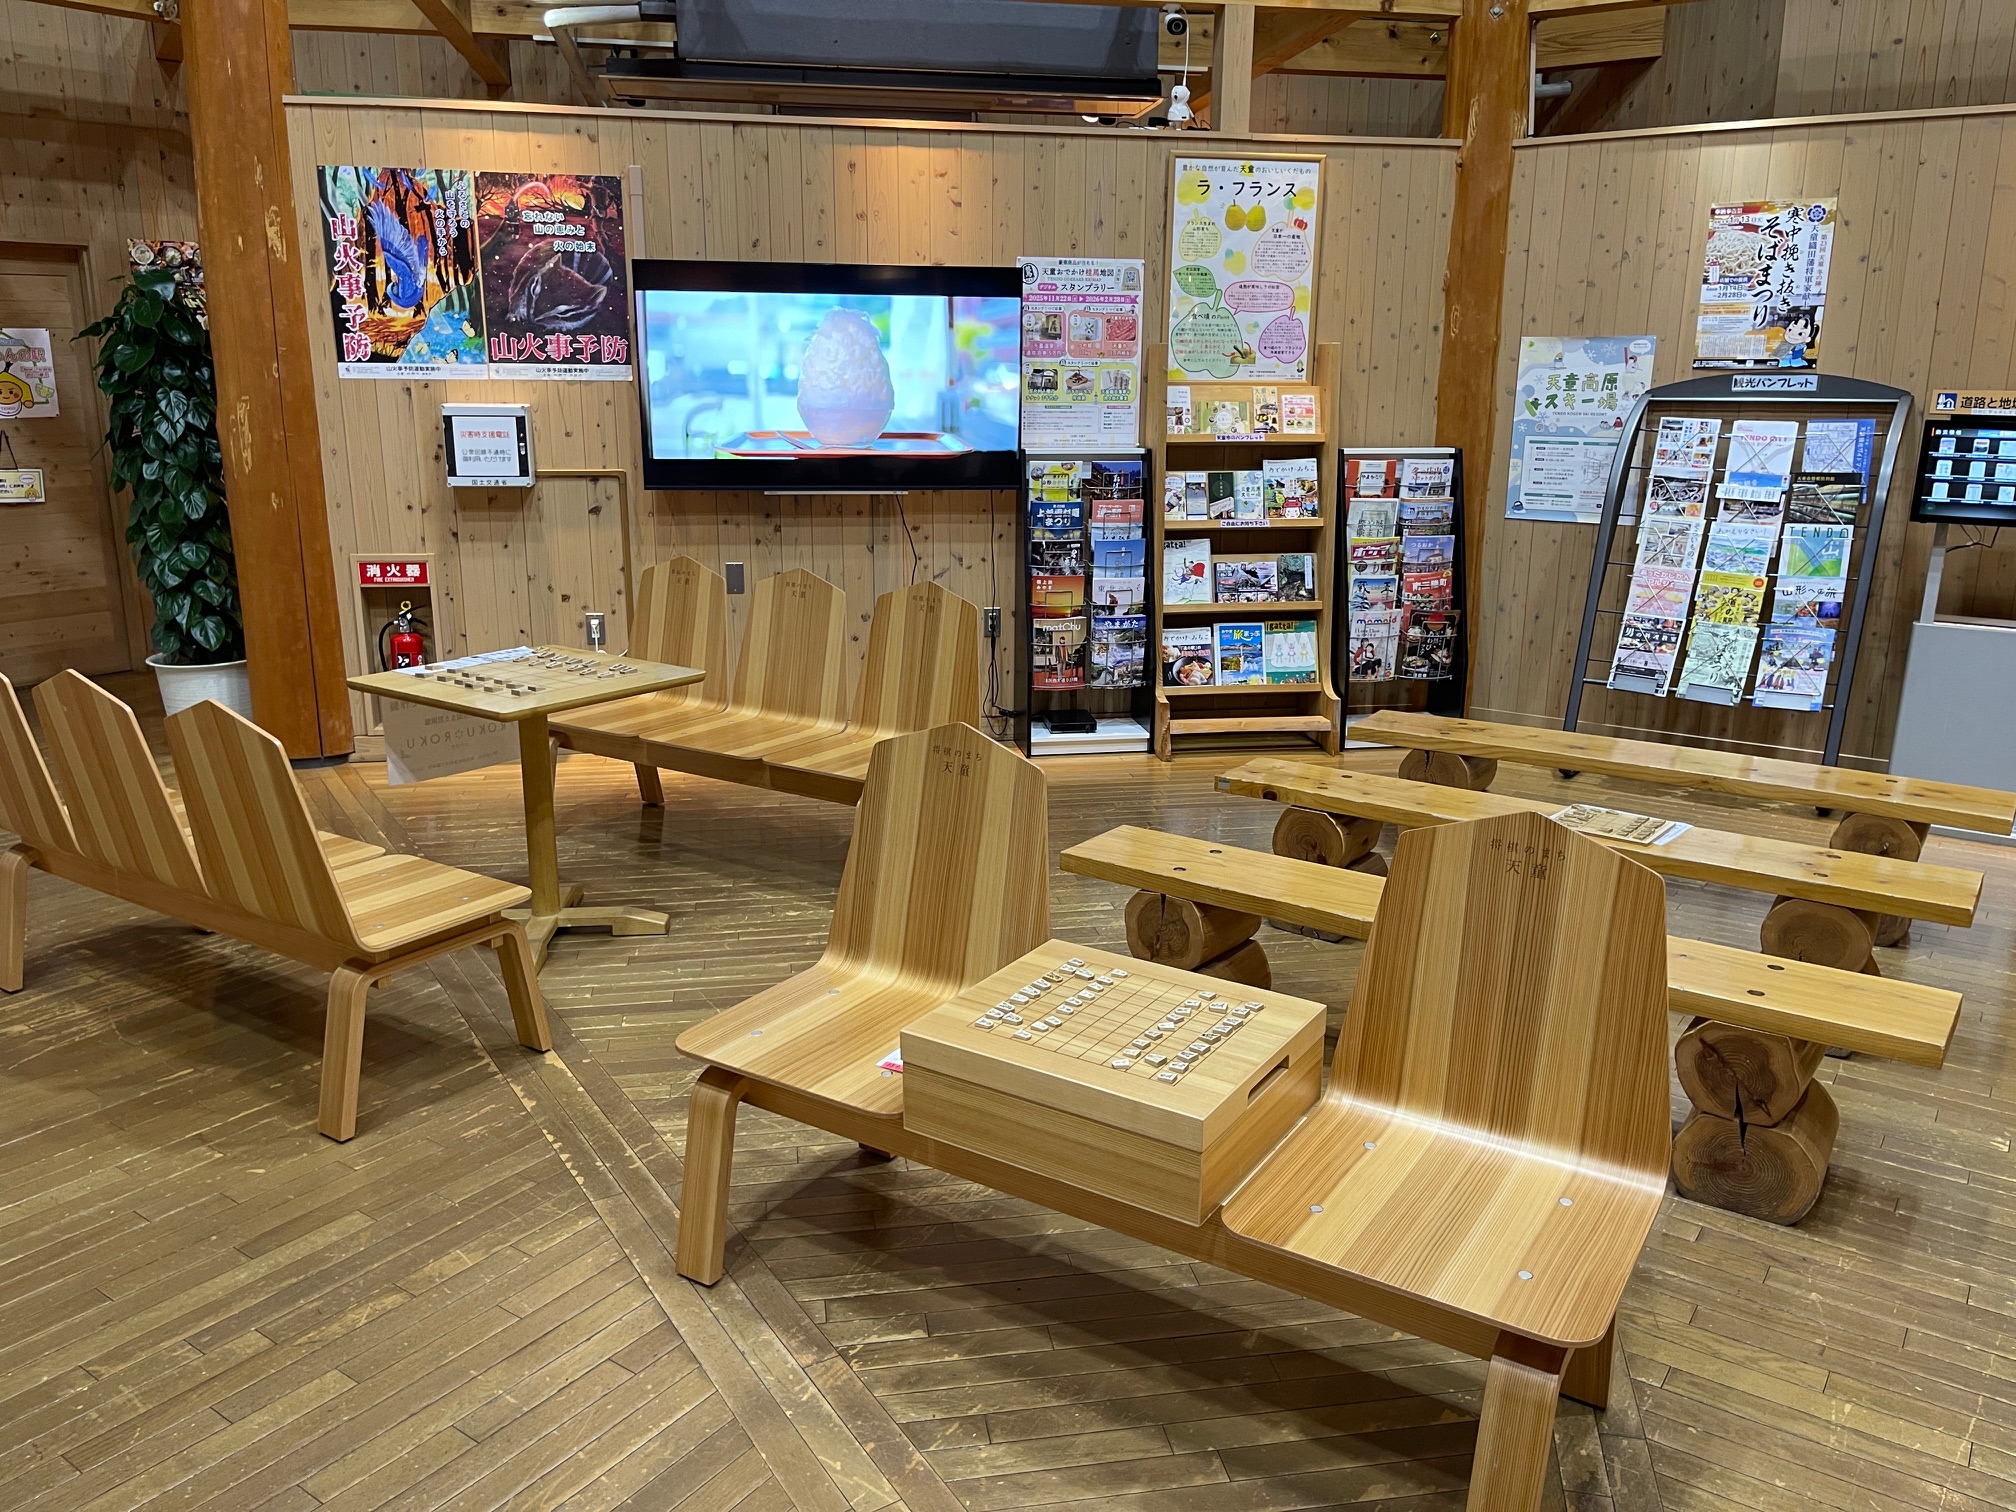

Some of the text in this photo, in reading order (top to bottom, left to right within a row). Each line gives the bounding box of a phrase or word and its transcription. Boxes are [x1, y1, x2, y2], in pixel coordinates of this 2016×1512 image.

[1182, 164, 1312, 175] 豊かな自然が育んだ天童のおいしいくだもの
[1197, 179, 1297, 197] ラ・フランス
[457, 181, 470, 229] ふるさとの
[444, 190, 458, 238] 山を守ろう
[522, 211, 565, 223] 忘れない
[434, 209, 448, 256] 火の手から
[533, 223, 586, 236] 山の恵みと
[553, 240, 597, 253] 火の始末
[1776, 206, 1805, 313] 寒中挽き抜き
[1041, 267, 1115, 277] 天童おでかけ桂馬地図
[1751, 216, 1783, 328] そばまつり
[330, 213, 371, 362] 山火事予防
[1060, 283, 1115, 292] スタンプラリー
[490, 332, 628, 364] 山火事予防
[1545, 372, 1619, 392] 天童高原
[1733, 377, 1813, 389] 観光パンフレット
[1544, 392, 1619, 412] スキー場
[460, 430, 510, 439] 災害時支援電話
[1045, 518, 1071, 526] まつり
[366, 563, 421, 577] 消火器
[1412, 578, 1447, 591] 南三陸町
[1104, 620, 1139, 628] やまがた
[1269, 622, 1293, 631] gatta!
[932, 744, 982, 761] 将棋のまち
[941, 761, 970, 777] 天童
[1489, 838, 1566, 861] 将棋のまち
[1505, 858, 1547, 880] 天童
